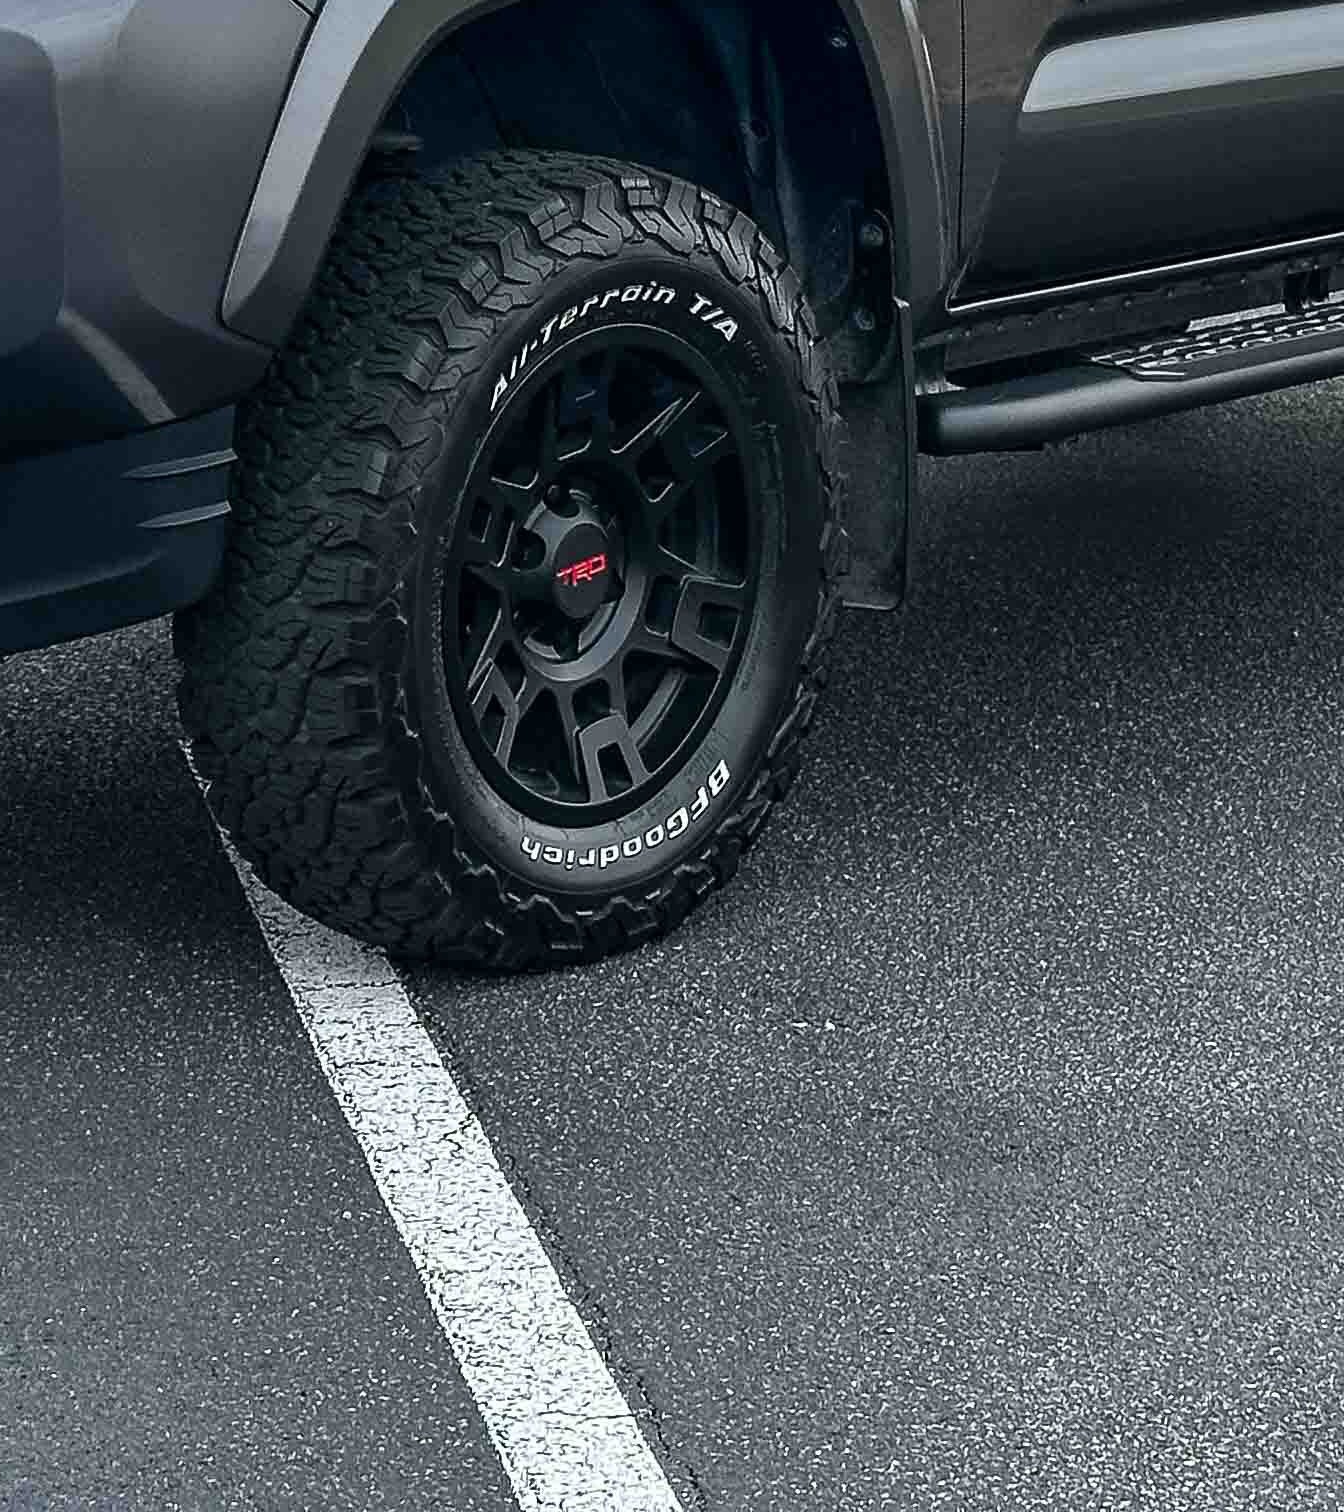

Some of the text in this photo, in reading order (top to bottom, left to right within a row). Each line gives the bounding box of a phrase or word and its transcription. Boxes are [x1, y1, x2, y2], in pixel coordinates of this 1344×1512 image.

[490, 283, 677, 412] All-Terrain
[688, 293, 740, 343] T/A
[520, 758, 731, 870] BFGoodrich
